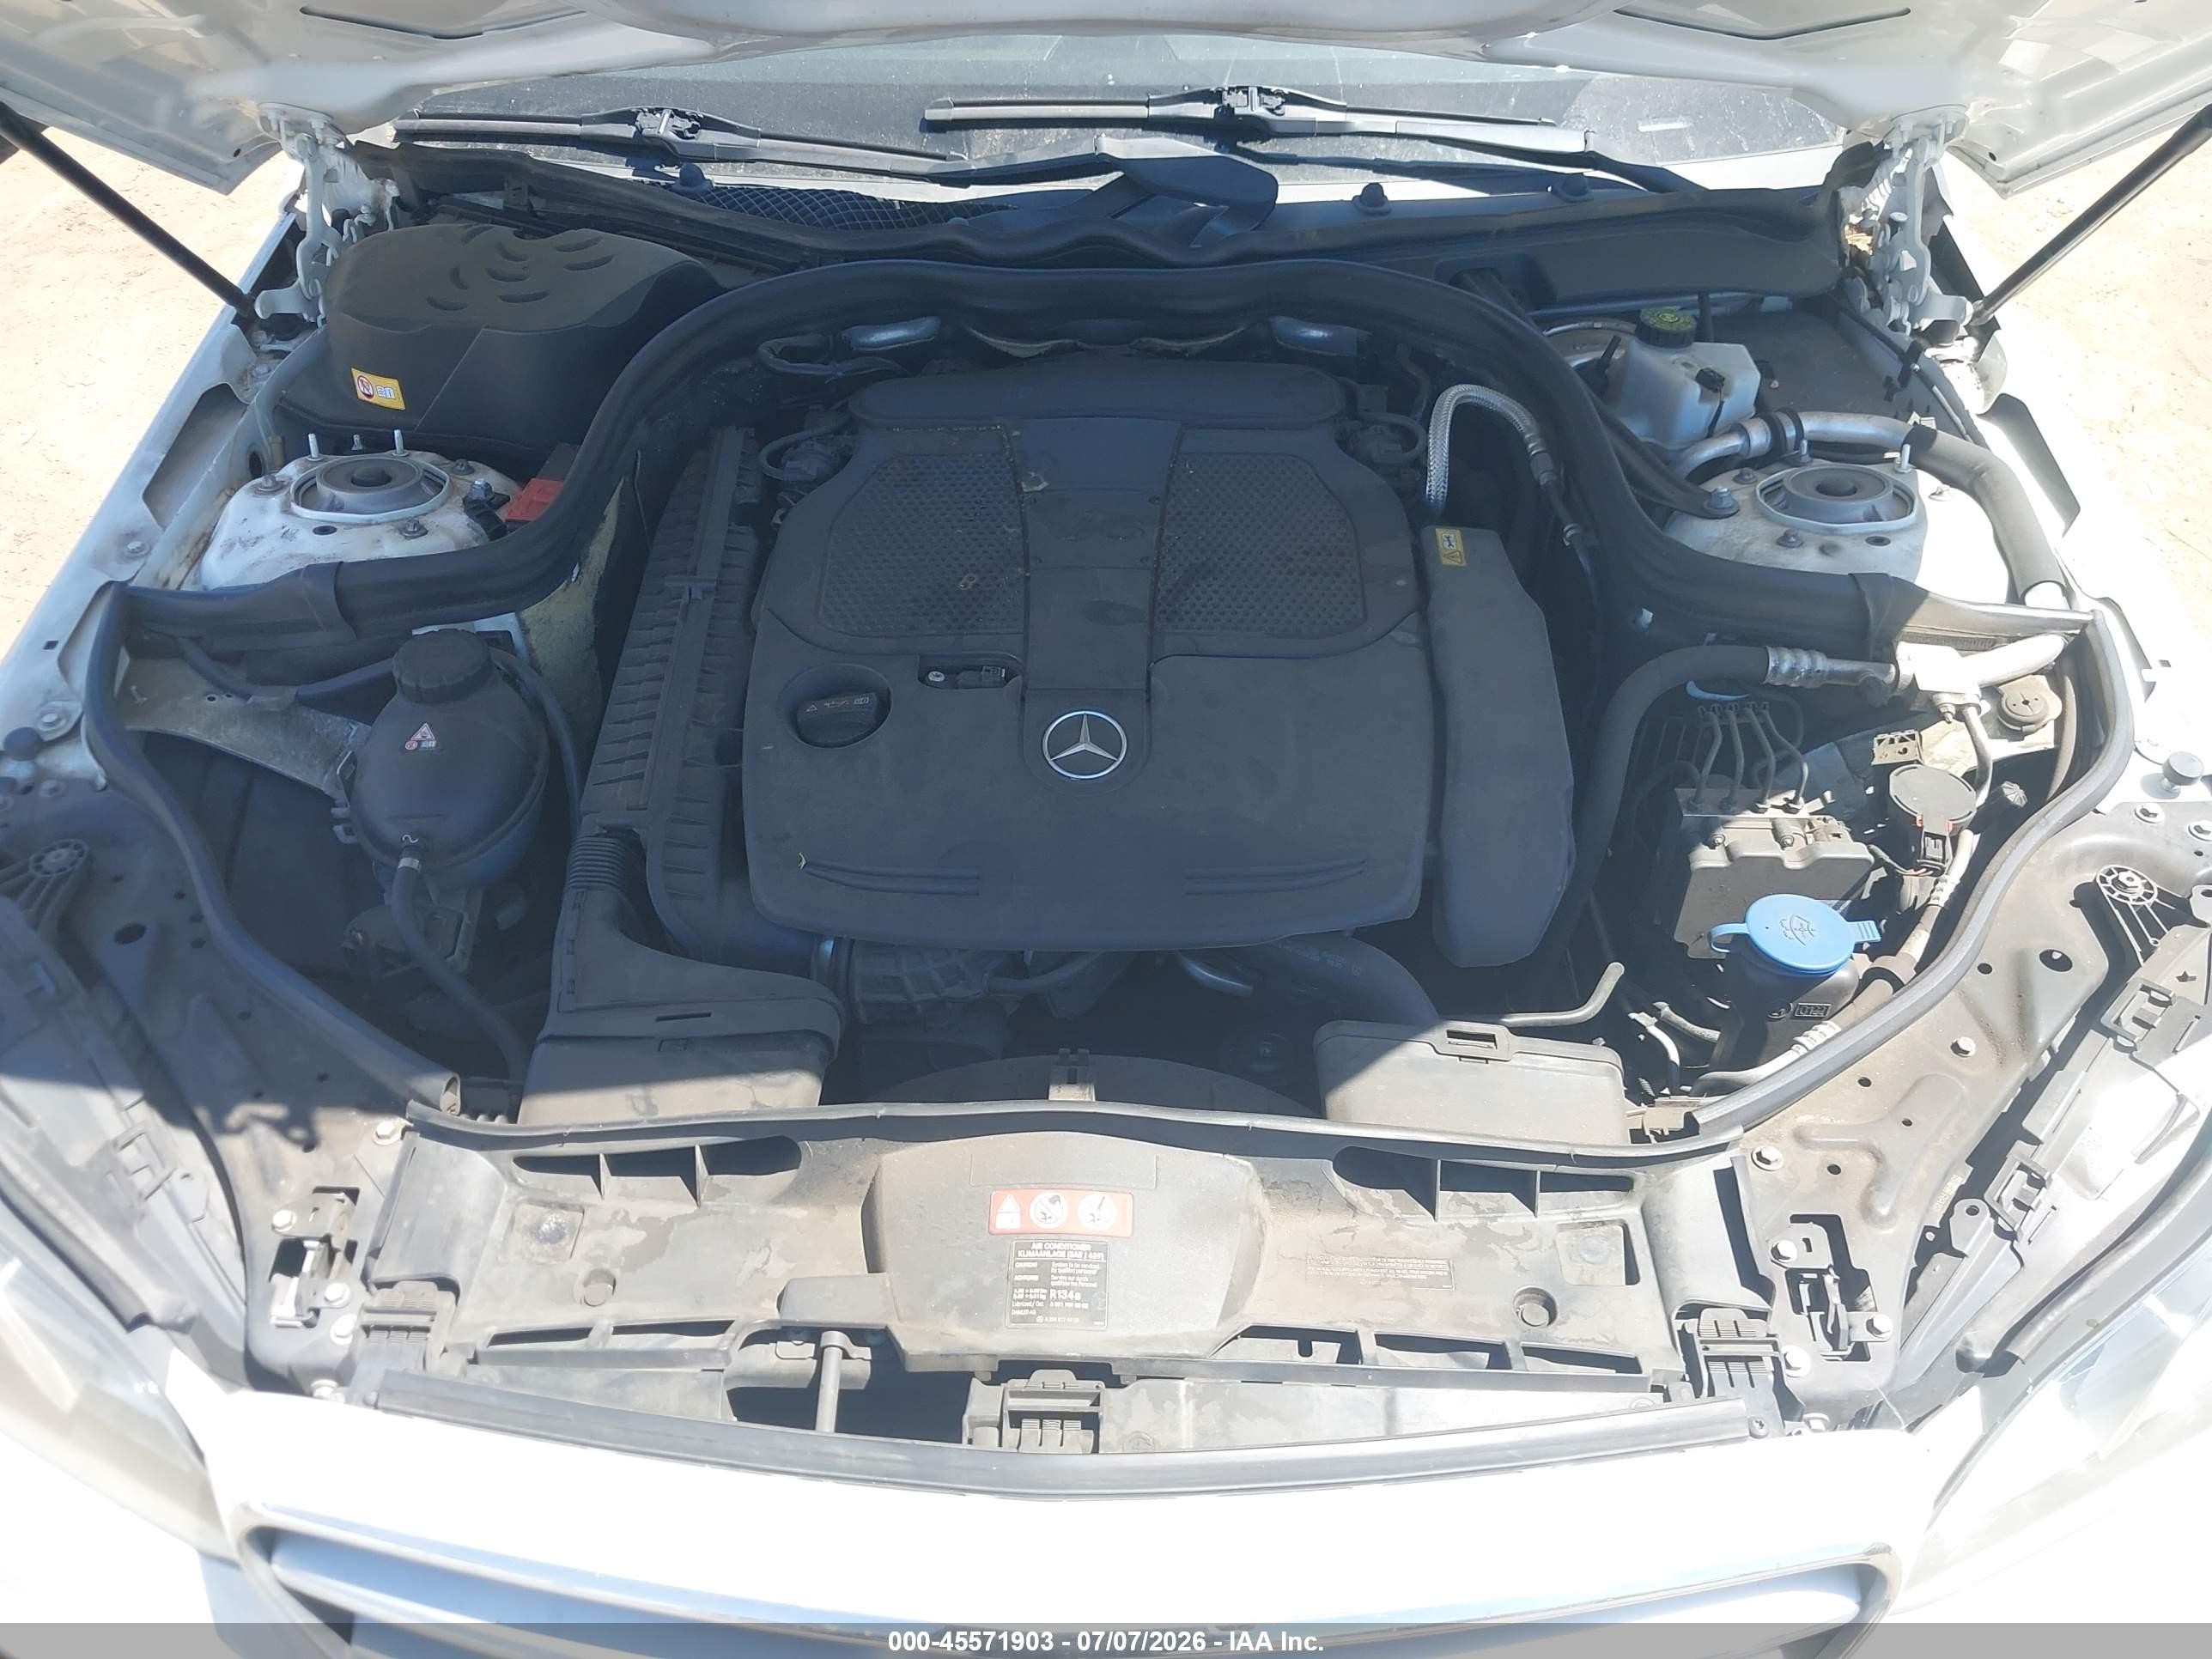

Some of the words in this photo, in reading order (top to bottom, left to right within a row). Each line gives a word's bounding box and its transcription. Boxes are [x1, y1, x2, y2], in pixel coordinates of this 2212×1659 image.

[1030, 1242, 1043, 1250] AIR
[1043, 1243, 1091, 1251] CONDITIONER
[1018, 1249, 1066, 1258] KLIMAANLAGE
